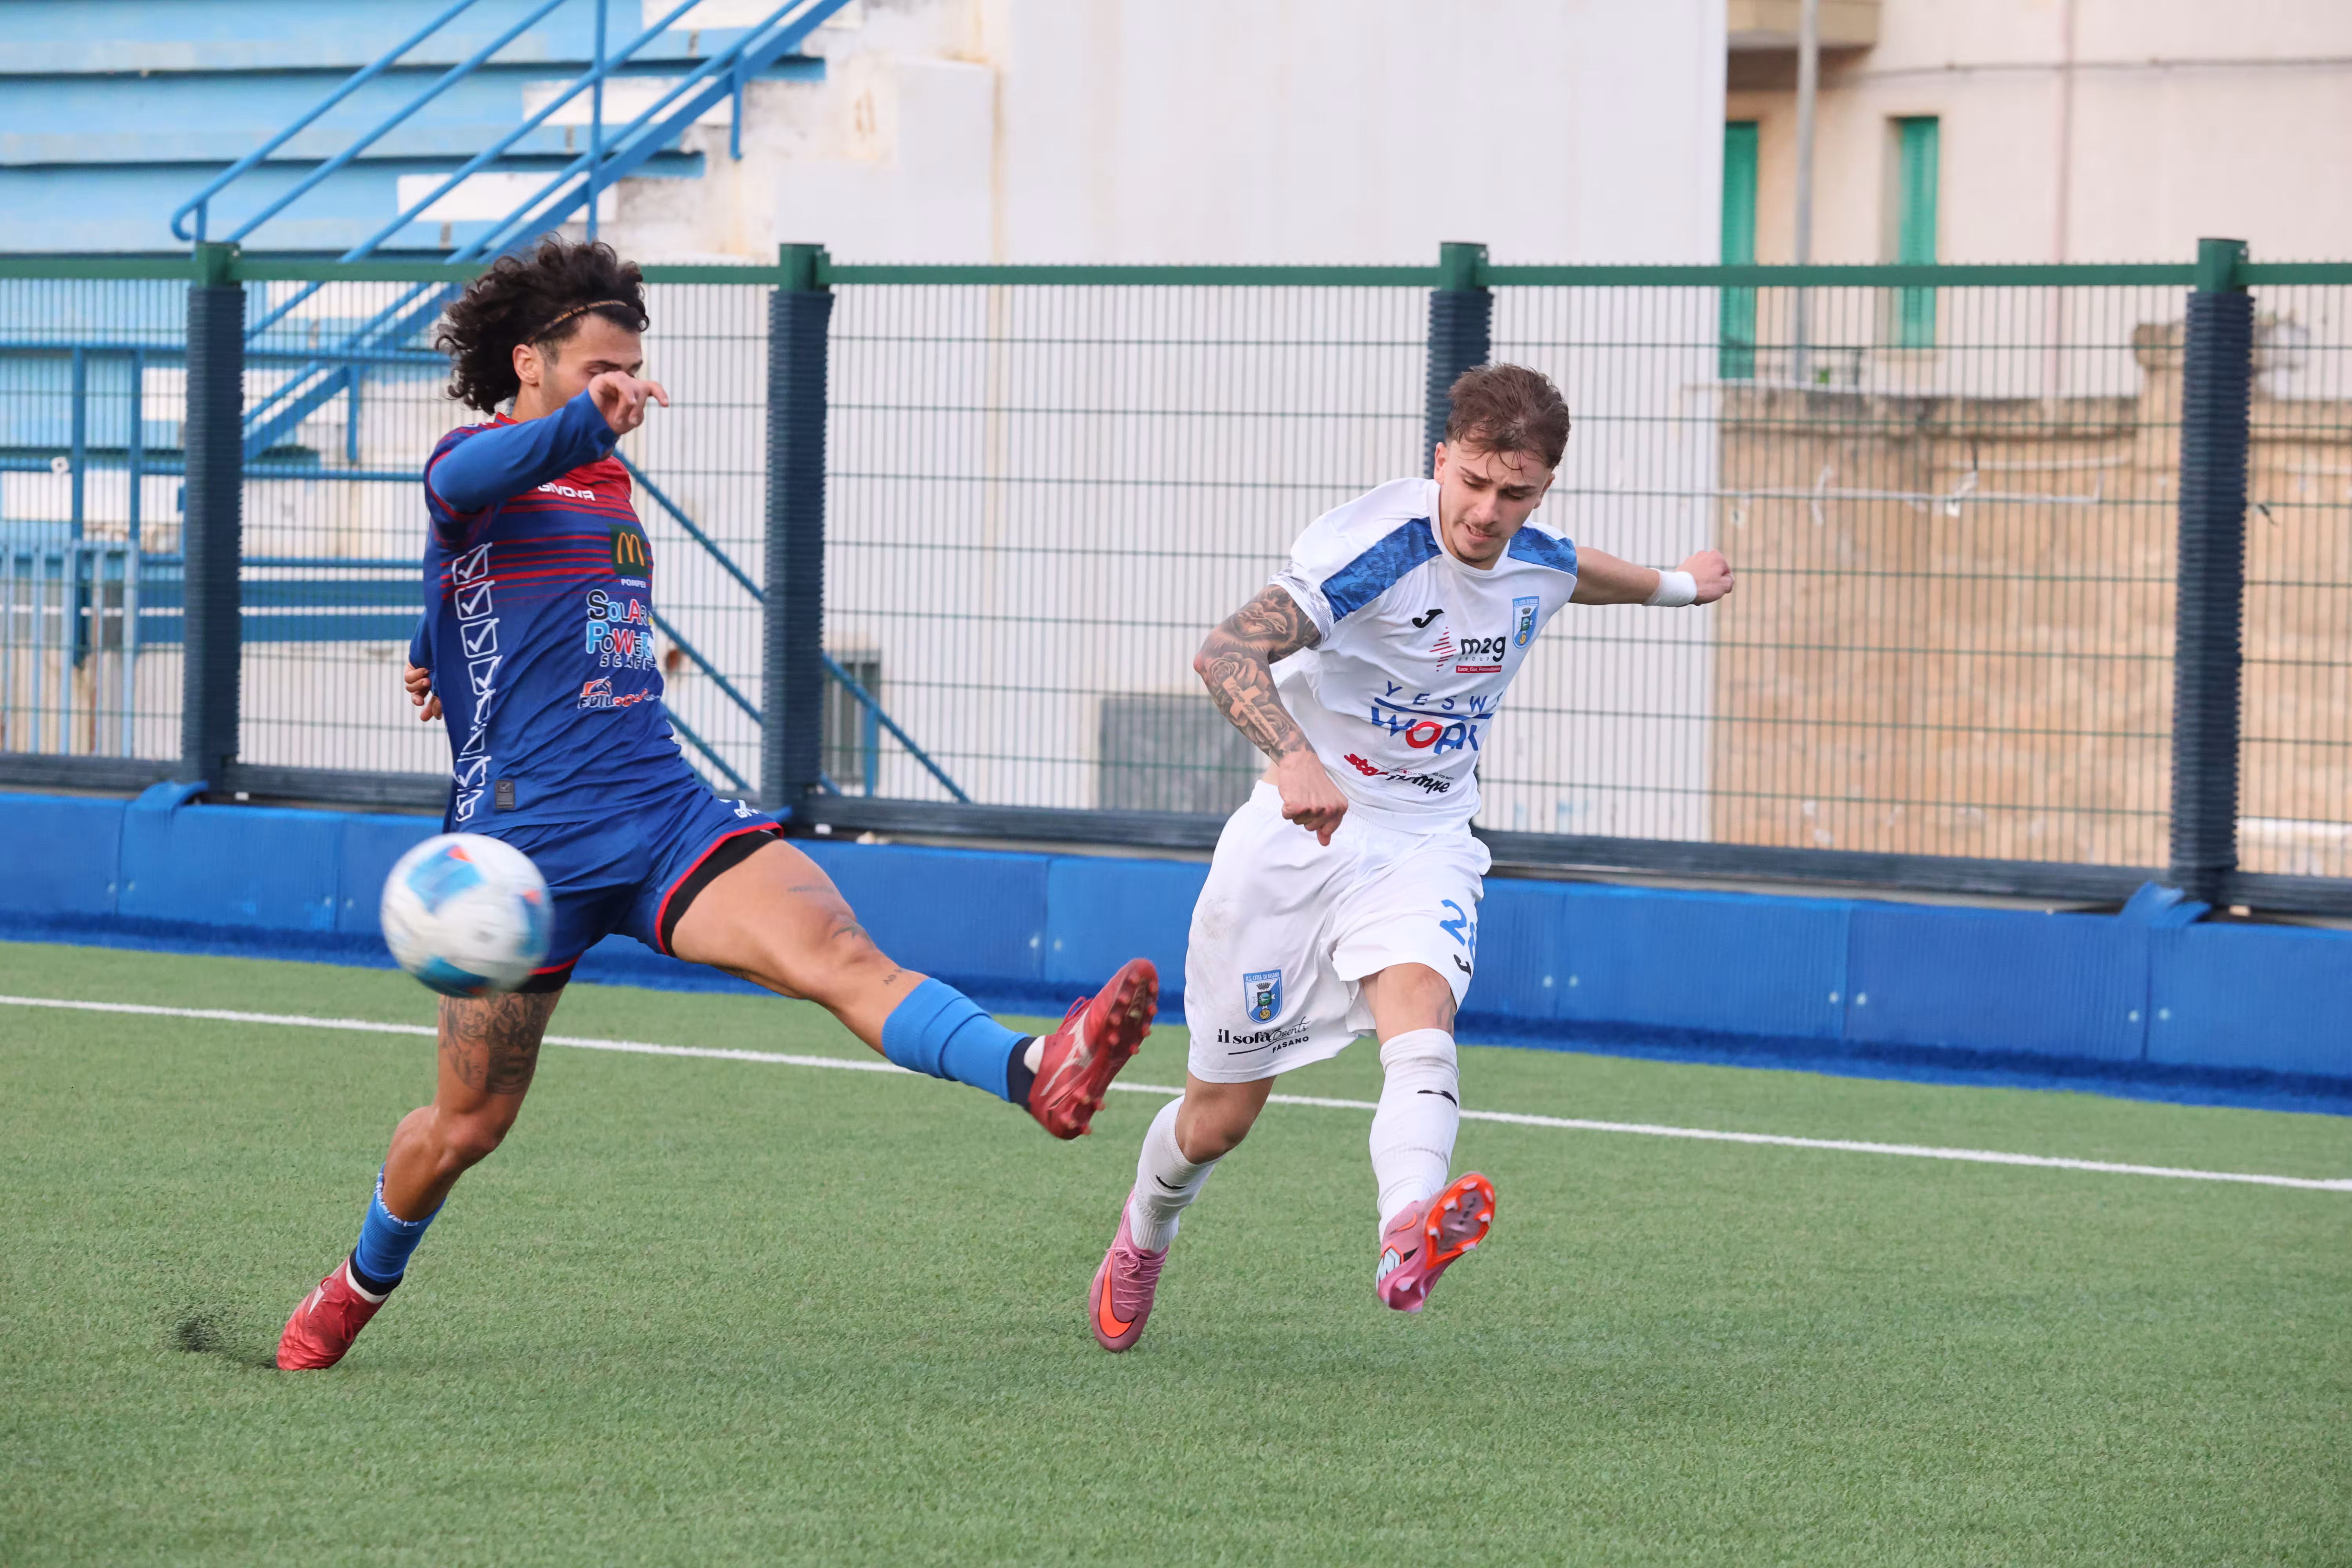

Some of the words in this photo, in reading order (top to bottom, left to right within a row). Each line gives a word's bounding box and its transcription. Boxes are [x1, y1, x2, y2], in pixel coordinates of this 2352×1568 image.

[1461, 636, 1506, 662] m2g
[1217, 1029, 1230, 1043] il
[1272, 1036, 1309, 1053] FASANO
